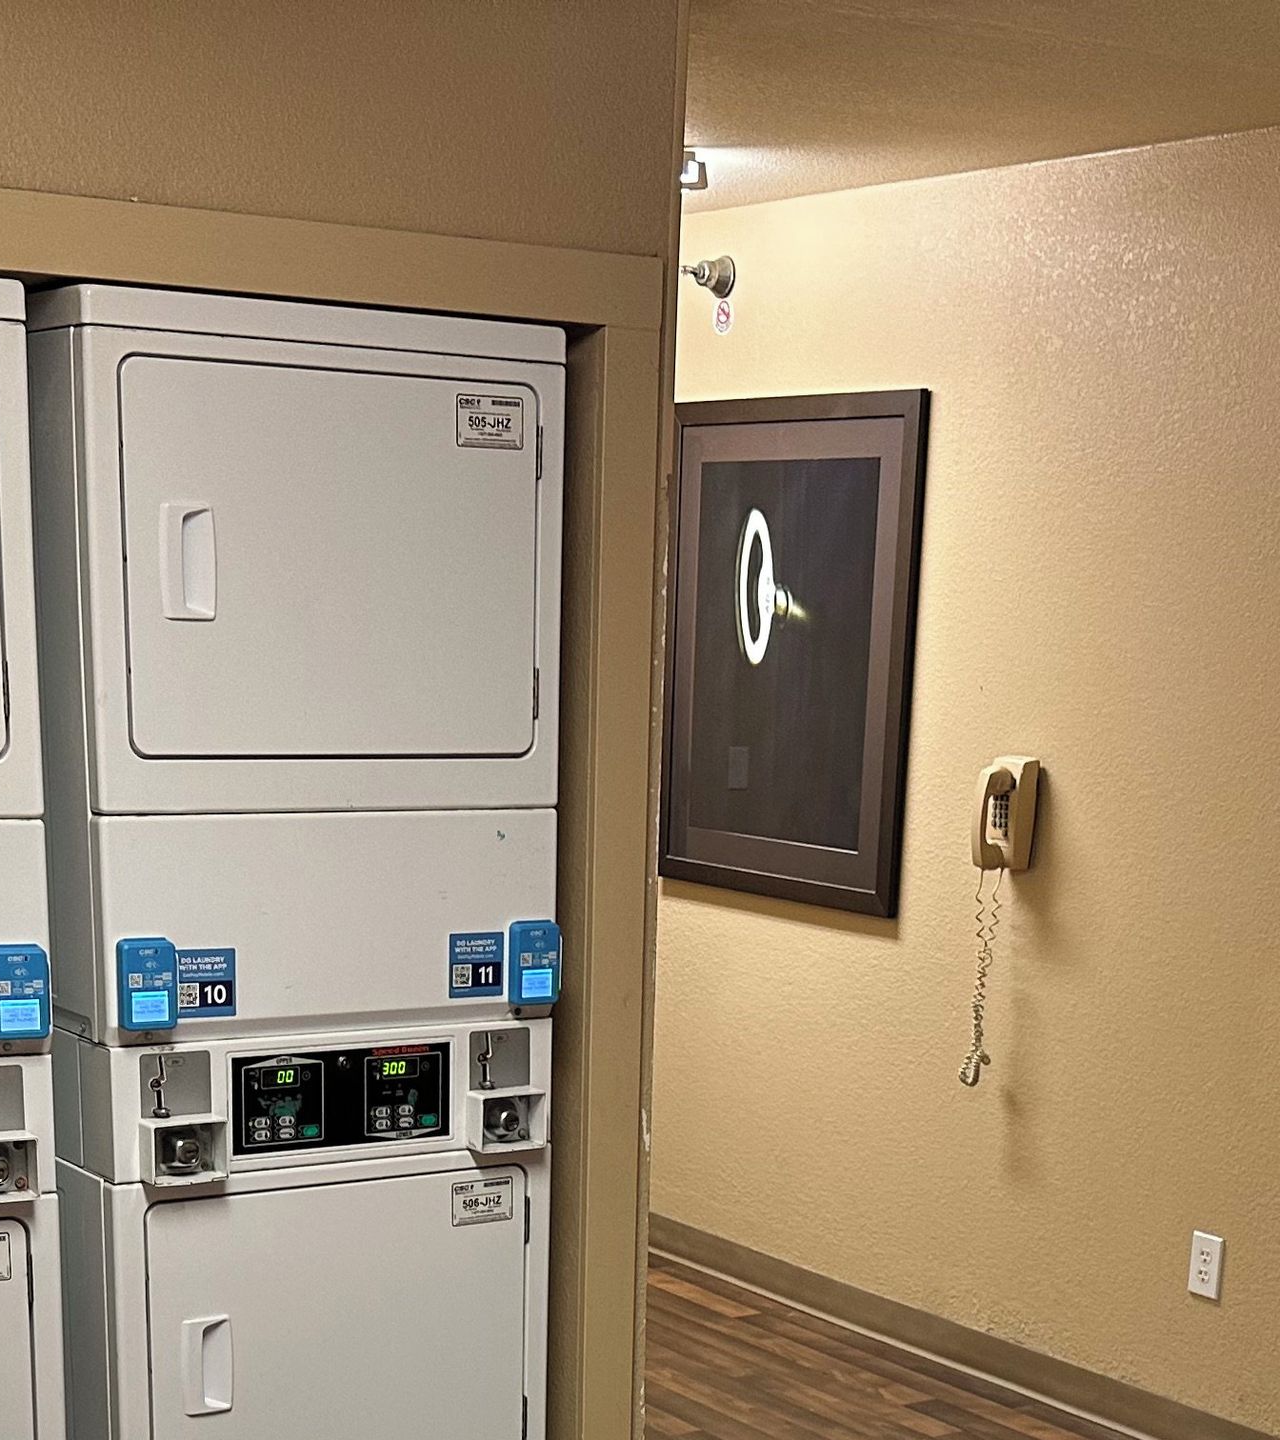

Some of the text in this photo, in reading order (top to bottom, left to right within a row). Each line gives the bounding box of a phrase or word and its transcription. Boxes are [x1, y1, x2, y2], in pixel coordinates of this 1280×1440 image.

[468, 416, 512, 429] 505-JHZ
[478, 966, 492, 984] 11
[204, 985, 226, 1004] 10
[382, 1062, 406, 1075] 300
[277, 1070, 294, 1083] 00
[462, 1195, 502, 1209] 506-JHZ
